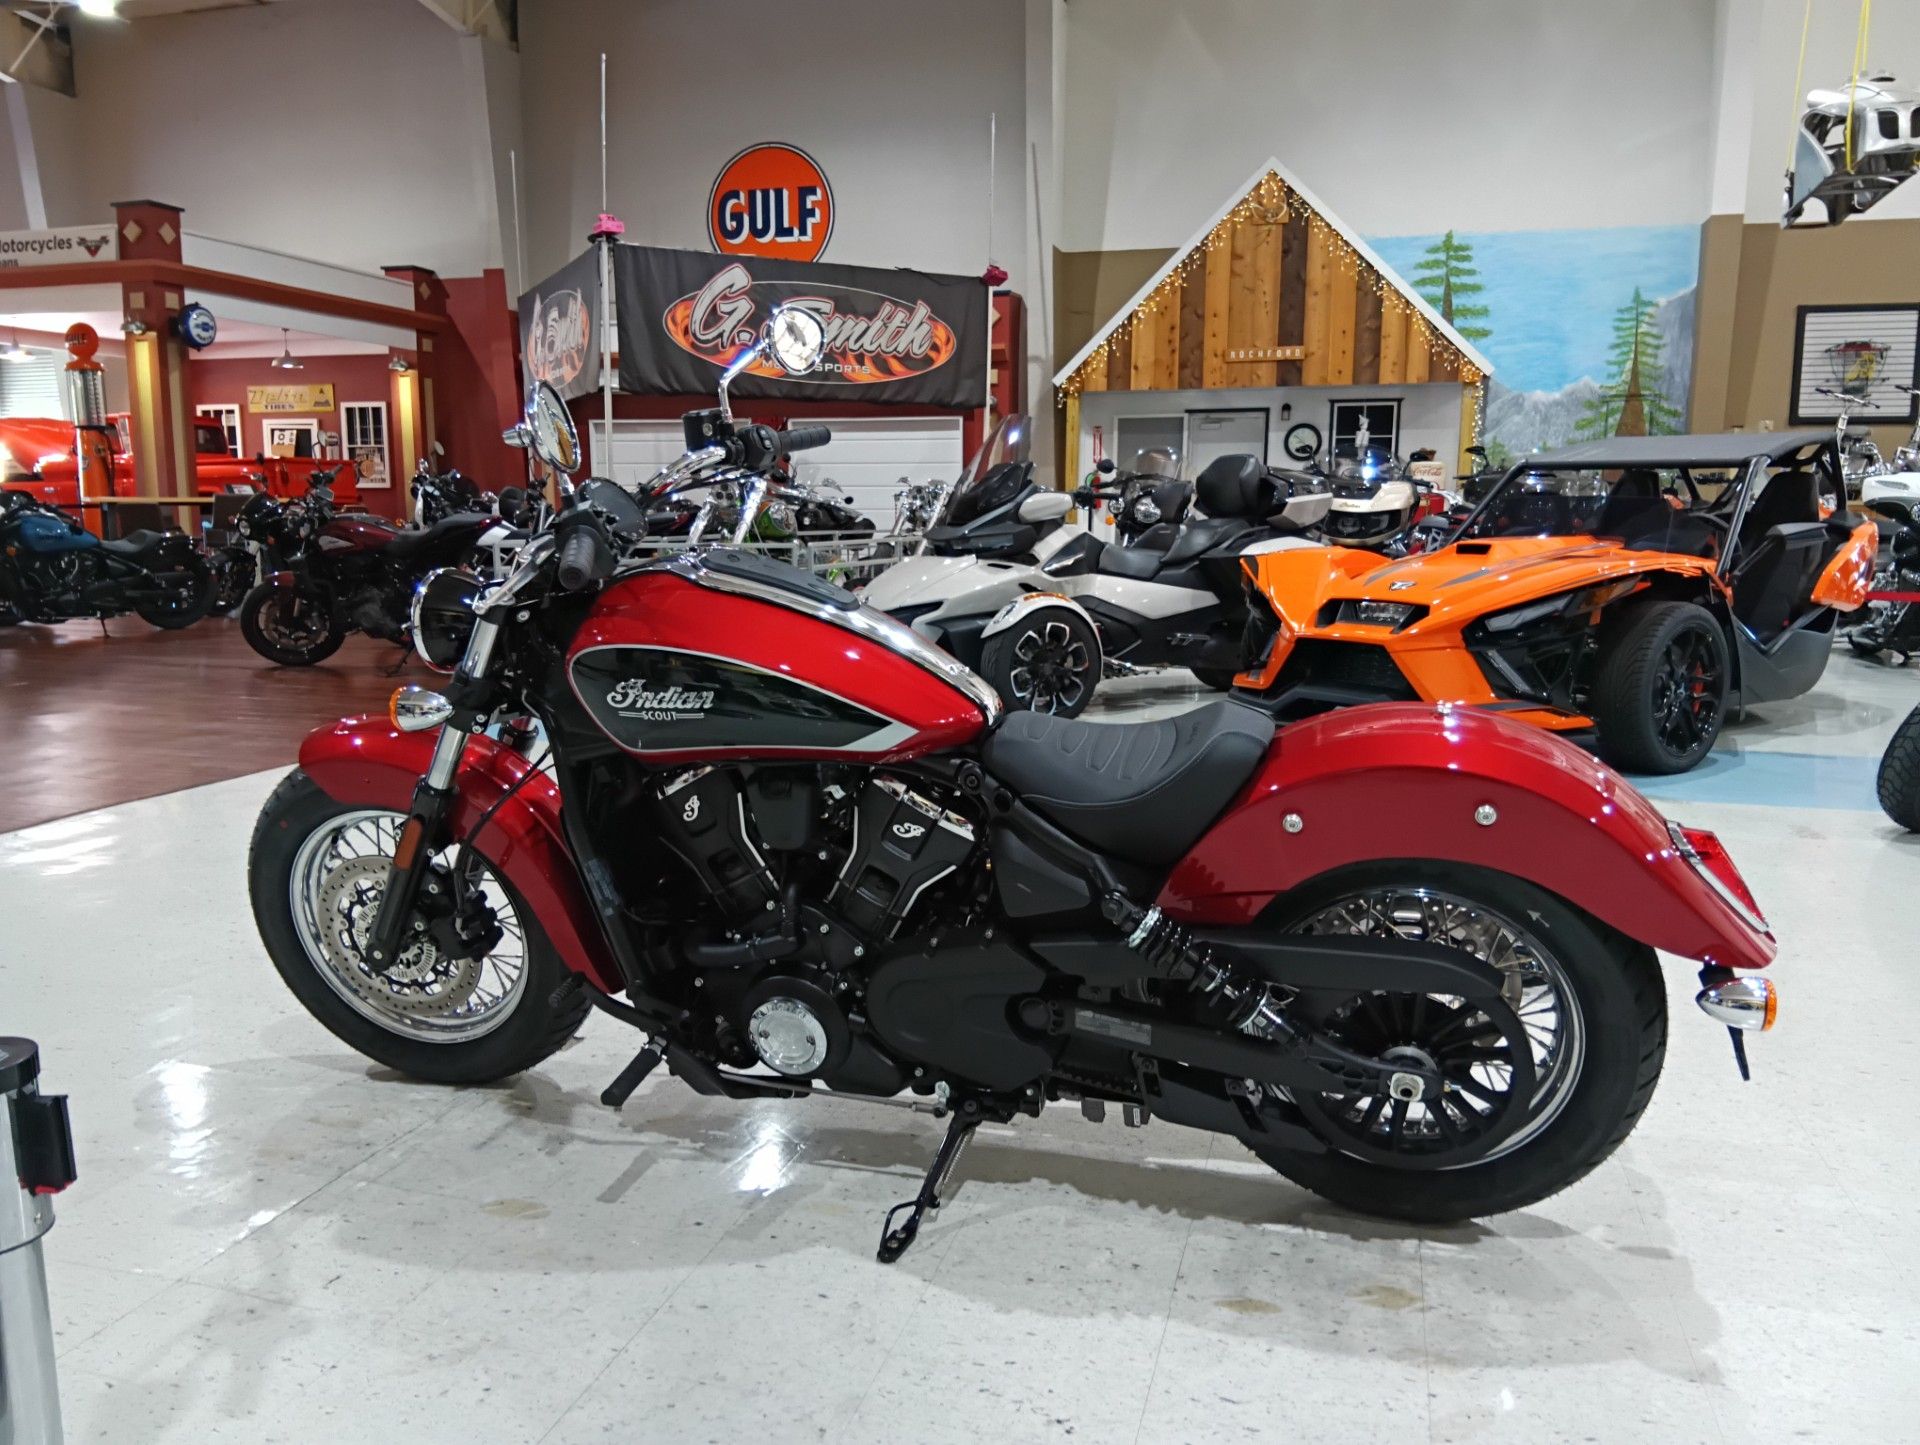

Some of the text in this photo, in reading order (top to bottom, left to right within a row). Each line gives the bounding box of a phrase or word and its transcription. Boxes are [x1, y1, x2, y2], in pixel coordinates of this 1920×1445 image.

[718, 186, 822, 245] GULF
[0, 235, 73, 254] otorcycles
[1230, 348, 1301, 359] ROCHFORD
[606, 678, 715, 709] Indian
[642, 710, 677, 720] SCOUT
